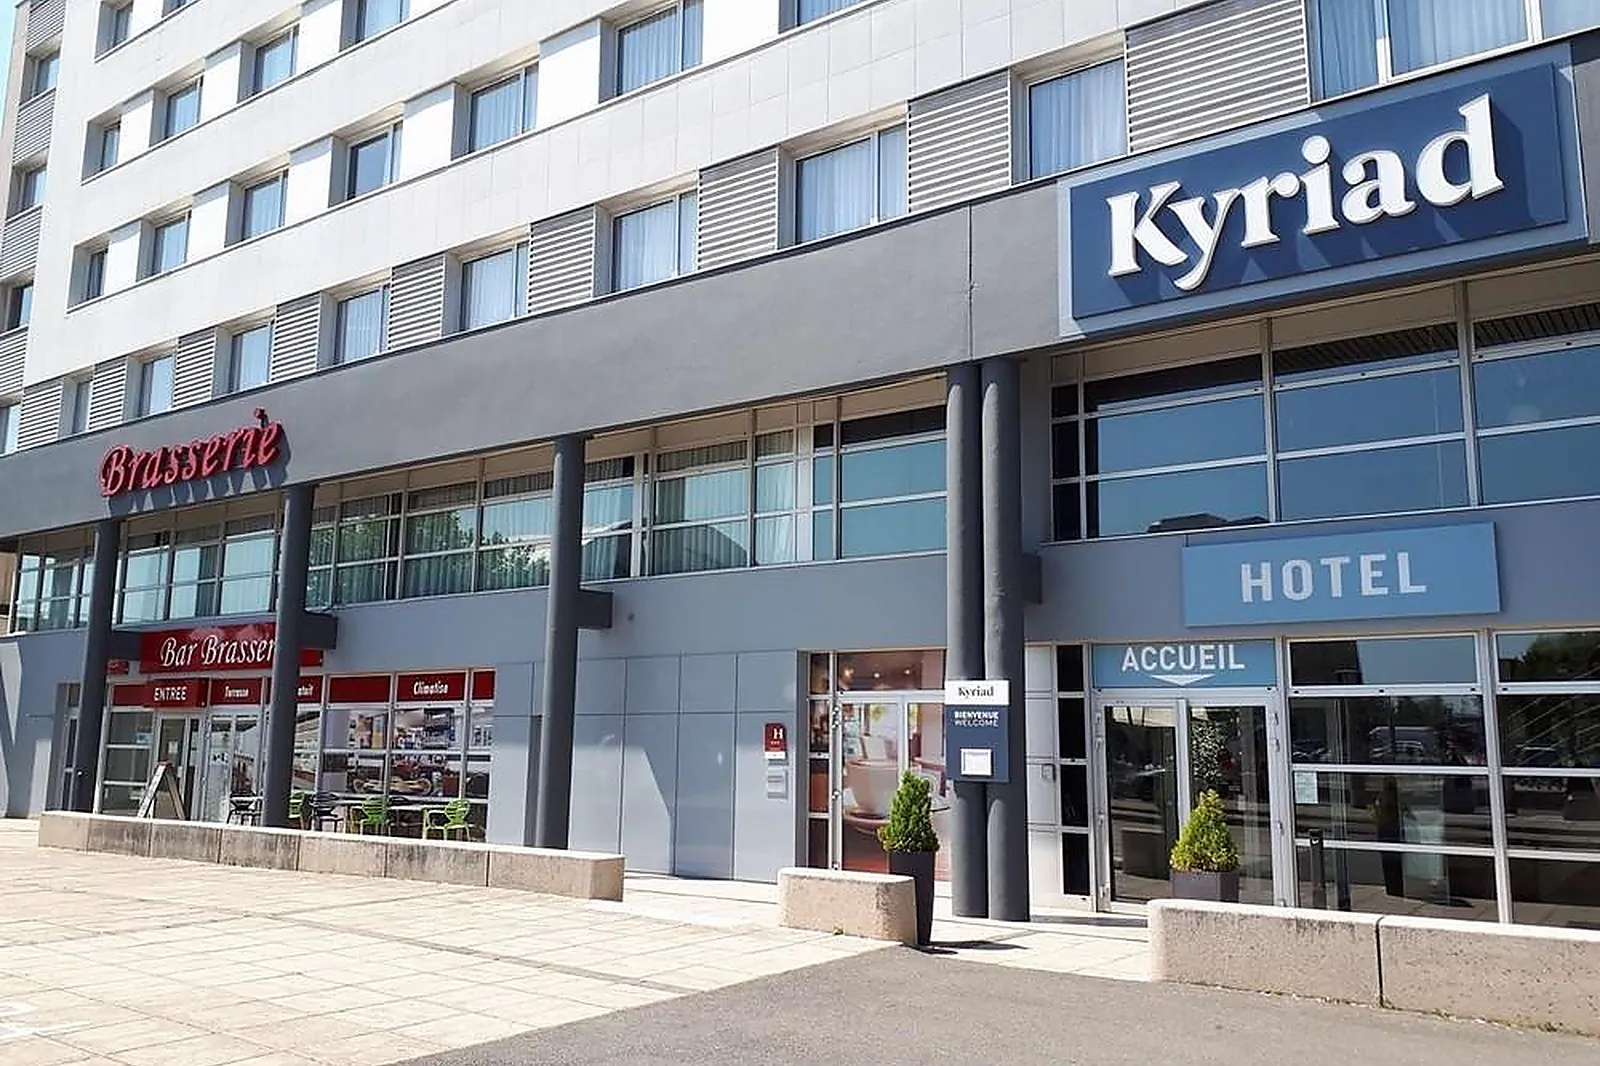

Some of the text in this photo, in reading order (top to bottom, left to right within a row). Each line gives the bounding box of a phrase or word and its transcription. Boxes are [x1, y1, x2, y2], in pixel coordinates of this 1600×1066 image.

[1105, 92, 1505, 291] Kyriad
[100, 407, 283, 497] Brasserie
[1240, 552, 1427, 603] HOTEL
[160, 635, 276, 666] Bar Brasser
[1121, 644, 1245, 673] ACCUEIL
[958, 686, 994, 699] Kyriad
[954, 711, 999, 719] BIENVENUE
[954, 719, 999, 728] WELCOME
